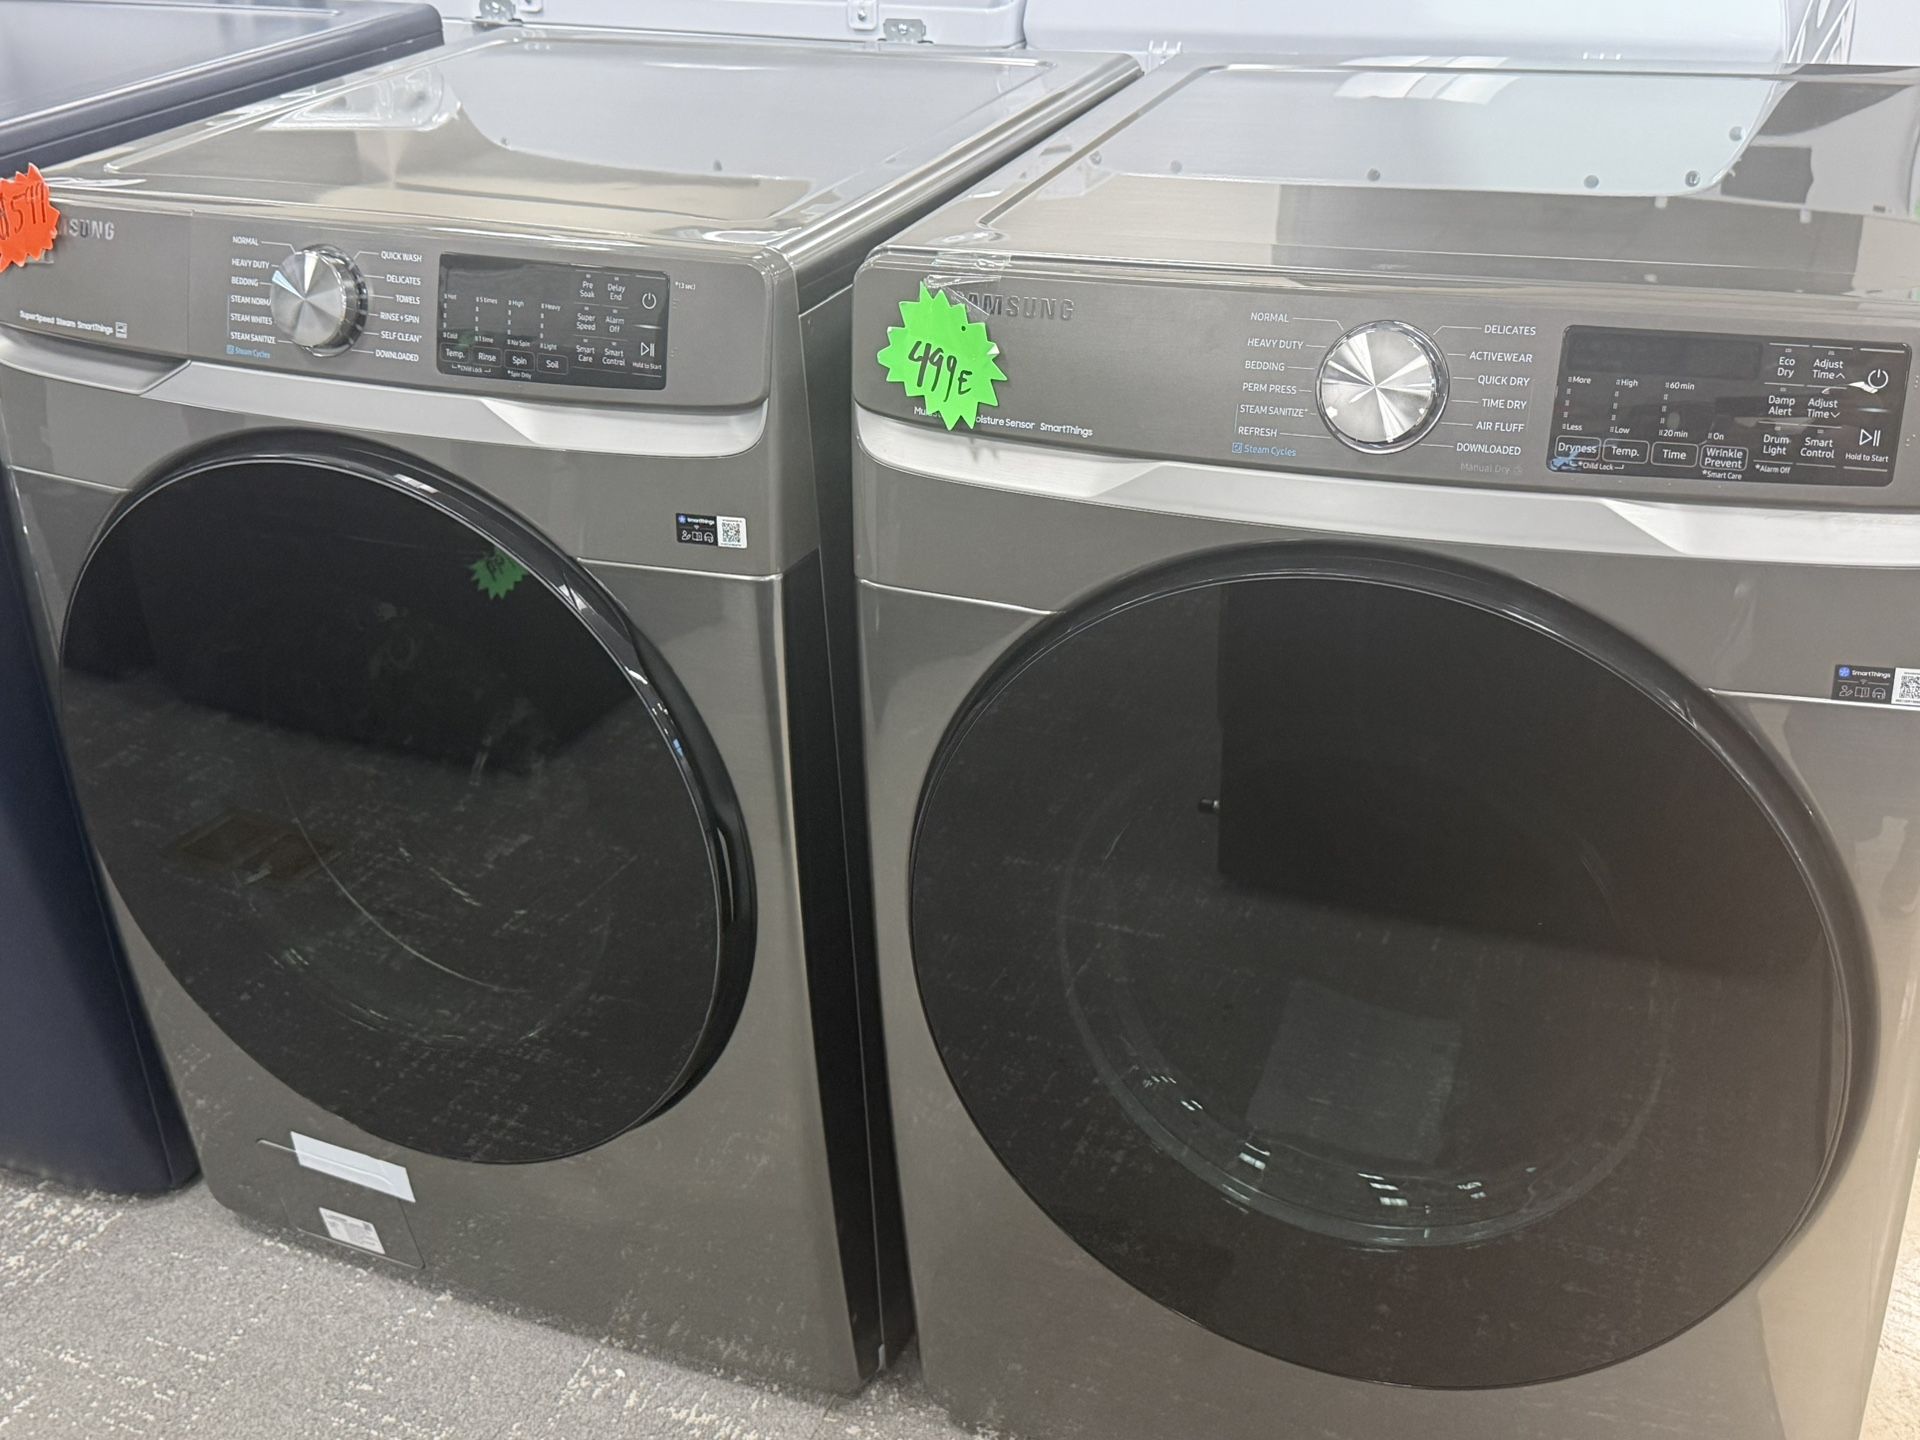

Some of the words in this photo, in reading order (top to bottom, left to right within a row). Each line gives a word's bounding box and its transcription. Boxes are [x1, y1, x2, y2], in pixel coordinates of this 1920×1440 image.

[232, 236, 259, 246] NORMAL
[381, 250, 401, 261] QUICK
[402, 253, 422, 262] WASH
[231, 258, 252, 267] HEAVY
[252, 260, 270, 269] DUTY
[231, 276, 259, 287] BEDDING
[386, 274, 421, 286] DELICATES
[582, 280, 594, 289] Pre
[607, 283, 626, 294] Delay
[231, 295, 250, 304] STEAM
[395, 294, 420, 305] TOWELS
[610, 292, 622, 301] End
[230, 313, 250, 322] STEAM
[251, 315, 273, 325] WHITES
[380, 312, 400, 322] RINSE
[404, 315, 420, 323] SPIN
[605, 315, 624, 325] Alarm
[1250, 312, 1289, 323] NORMAL
[380, 331, 396, 340] SELF
[1484, 324, 1537, 336] DELICATES
[230, 332, 250, 341] STEAM
[576, 344, 595, 354] Smart
[1247, 338, 1278, 348] HEAVY
[1278, 340, 1304, 350] DUTY
[375, 349, 419, 362] DOWNLOADED
[478, 352, 496, 362] Rinse
[604, 347, 624, 357] Smart
[1469, 351, 1533, 363] ACTIVEWEAR
[512, 355, 527, 366] Spin
[546, 359, 559, 369] Soil
[578, 354, 593, 363] Care
[602, 356, 626, 367] Control
[1778, 356, 1796, 366] Eco
[1813, 358, 1844, 370] Adjust
[1244, 360, 1286, 372] BEDDING
[1777, 367, 1794, 378] Dry
[1812, 369, 1835, 380] Time
[1477, 374, 1508, 387] QUICK
[1509, 376, 1530, 387] DRY
[1572, 376, 1592, 385] More
[1621, 379, 1639, 388] High
[1669, 381, 1680, 389] 60
[1680, 382, 1695, 390] min
[1242, 382, 1268, 393] PERM
[1269, 384, 1297, 395] PRESS
[1482, 398, 1505, 409] TIME
[1506, 400, 1527, 410] DRY
[1768, 395, 1796, 407] Damp
[1807, 397, 1838, 409] Adjust
[1239, 404, 1268, 415] STEAM
[1768, 406, 1793, 416] Alert
[1807, 408, 1829, 419] Time
[1005, 419, 1036, 430] Sensor
[1040, 422, 1094, 438] SmartThings
[1238, 426, 1278, 438] REFRESH
[1476, 421, 1493, 431] AIR
[1494, 422, 1525, 433] FLUFF
[1566, 423, 1583, 431] Less
[1614, 426, 1630, 434] Low
[1663, 429, 1674, 437] 20
[1674, 430, 1688, 438] min
[1713, 432, 1725, 440] On
[1763, 433, 1790, 445] Drum
[1804, 436, 1833, 448] Smart
[1244, 444, 1270, 454] Steam
[1270, 446, 1297, 457] Cycles
[1456, 442, 1522, 456] DOWNLOADED
[1558, 442, 1597, 454] Dryness
[1612, 446, 1640, 458] Temp.
[1706, 447, 1743, 459] Wrinkle
[1762, 444, 1787, 456] Light
[1800, 447, 1835, 459] Control
[1662, 449, 1687, 460] Time
[1845, 452, 1861, 461] Hold
[1862, 453, 1870, 461] to
[1871, 454, 1889, 463] Start
[1599, 463, 1614, 471] Lock
[1704, 457, 1742, 469] Prevent
[1460, 463, 1493, 473] Manual
[1495, 464, 1511, 475] Dry
[1779, 466, 1791, 474] Off
[1727, 471, 1742, 480] Care
[1851, 669, 1891, 679] SmartThings
